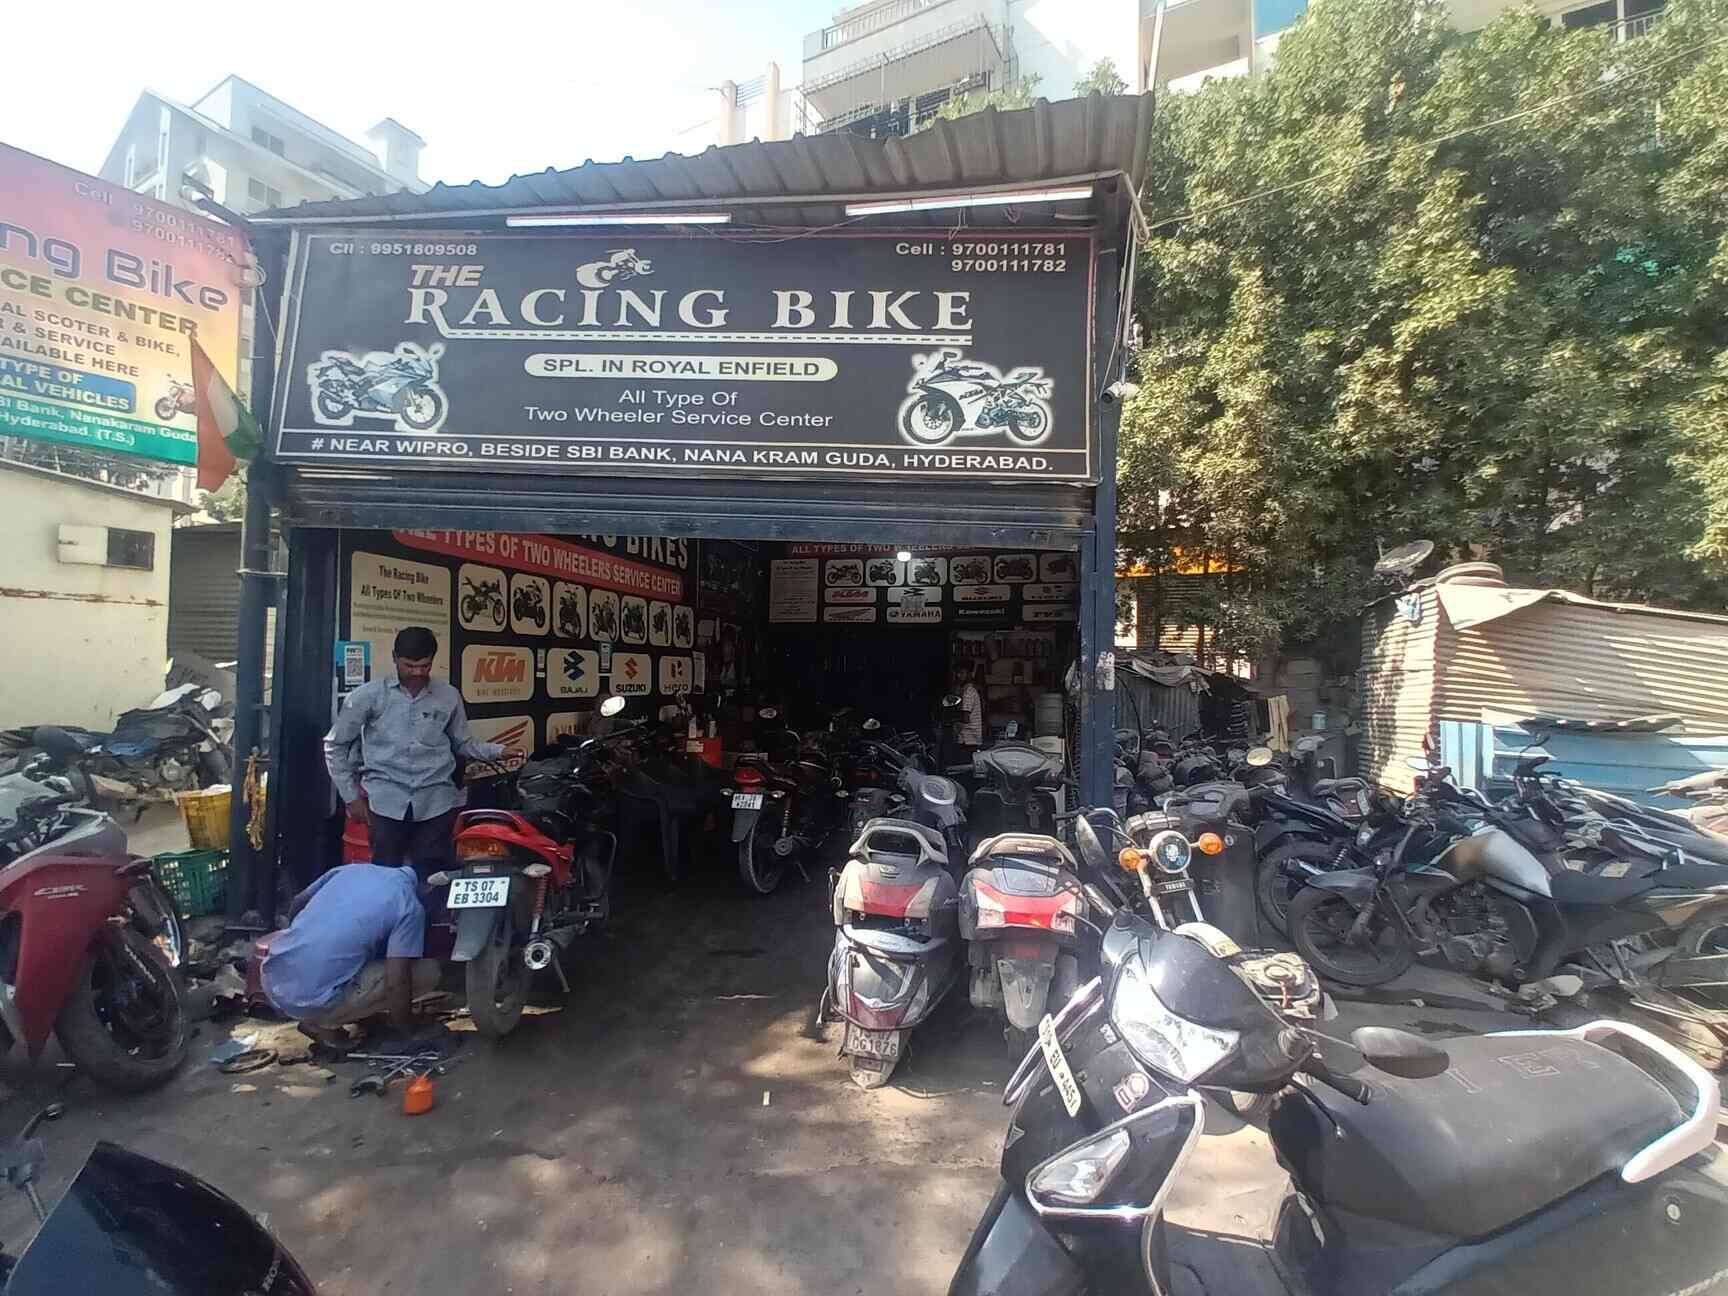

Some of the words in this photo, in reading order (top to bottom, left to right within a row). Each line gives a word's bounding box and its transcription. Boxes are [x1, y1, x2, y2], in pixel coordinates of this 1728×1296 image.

[370, 243, 478, 256] 9951809508
[895, 242, 933, 256] Cell
[952, 242, 1066, 256] 9700111781
[410, 264, 484, 287] THE
[951, 259, 1067, 272] 9700111782
[106, 248, 229, 312] Bike
[1, 268, 53, 298] CE
[65, 287, 199, 337] CENTER
[404, 286, 730, 331] RACING
[771, 289, 975, 331] BIKE
[34, 310, 110, 338] SCOTER
[117, 331, 129, 343] &
[34, 327, 116, 356] SERVICE
[92, 356, 140, 377] HERE
[602, 359, 624, 373] IN
[632, 360, 712, 375] ROYAL
[719, 362, 820, 376] ENFIELD
[58, 370, 84, 385] OF
[34, 380, 129, 410] VEHICLES
[619, 389, 646, 404] All
[653, 390, 705, 410] Type
[711, 391, 740, 406] Of
[525, 406, 568, 422] Two
[575, 407, 664, 424] Wheeler
[672, 409, 752, 426] Service
[759, 411, 833, 428] Center
[331, 438, 389, 453] NEAR
[396, 440, 474, 458] WIPRO,
[480, 442, 561, 459] BESIDE
[566, 444, 602, 460] SBI
[609, 445, 677, 463] BANK,
[684, 447, 747, 464] NANA
[753, 449, 819, 466] KRAM
[825, 451, 897, 469] GUDA,
[903, 453, 1054, 471] HYDERABAD.
[791, 545, 811, 554] ALL
[814, 544, 847, 553] TYPES
[500, 538, 518, 560] OF
[522, 540, 551, 567] TWO
[553, 547, 612, 582] WHEELERS
[612, 563, 650, 589] SERVICE
[650, 572, 682, 596] CENTER
[473, 651, 527, 683] KTM
[615, 683, 647, 693] SUZUKI
[465, 880, 478, 892] TS
[481, 880, 495, 891] 07
[454, 893, 469, 904] EB
[472, 891, 499, 904] 3304
